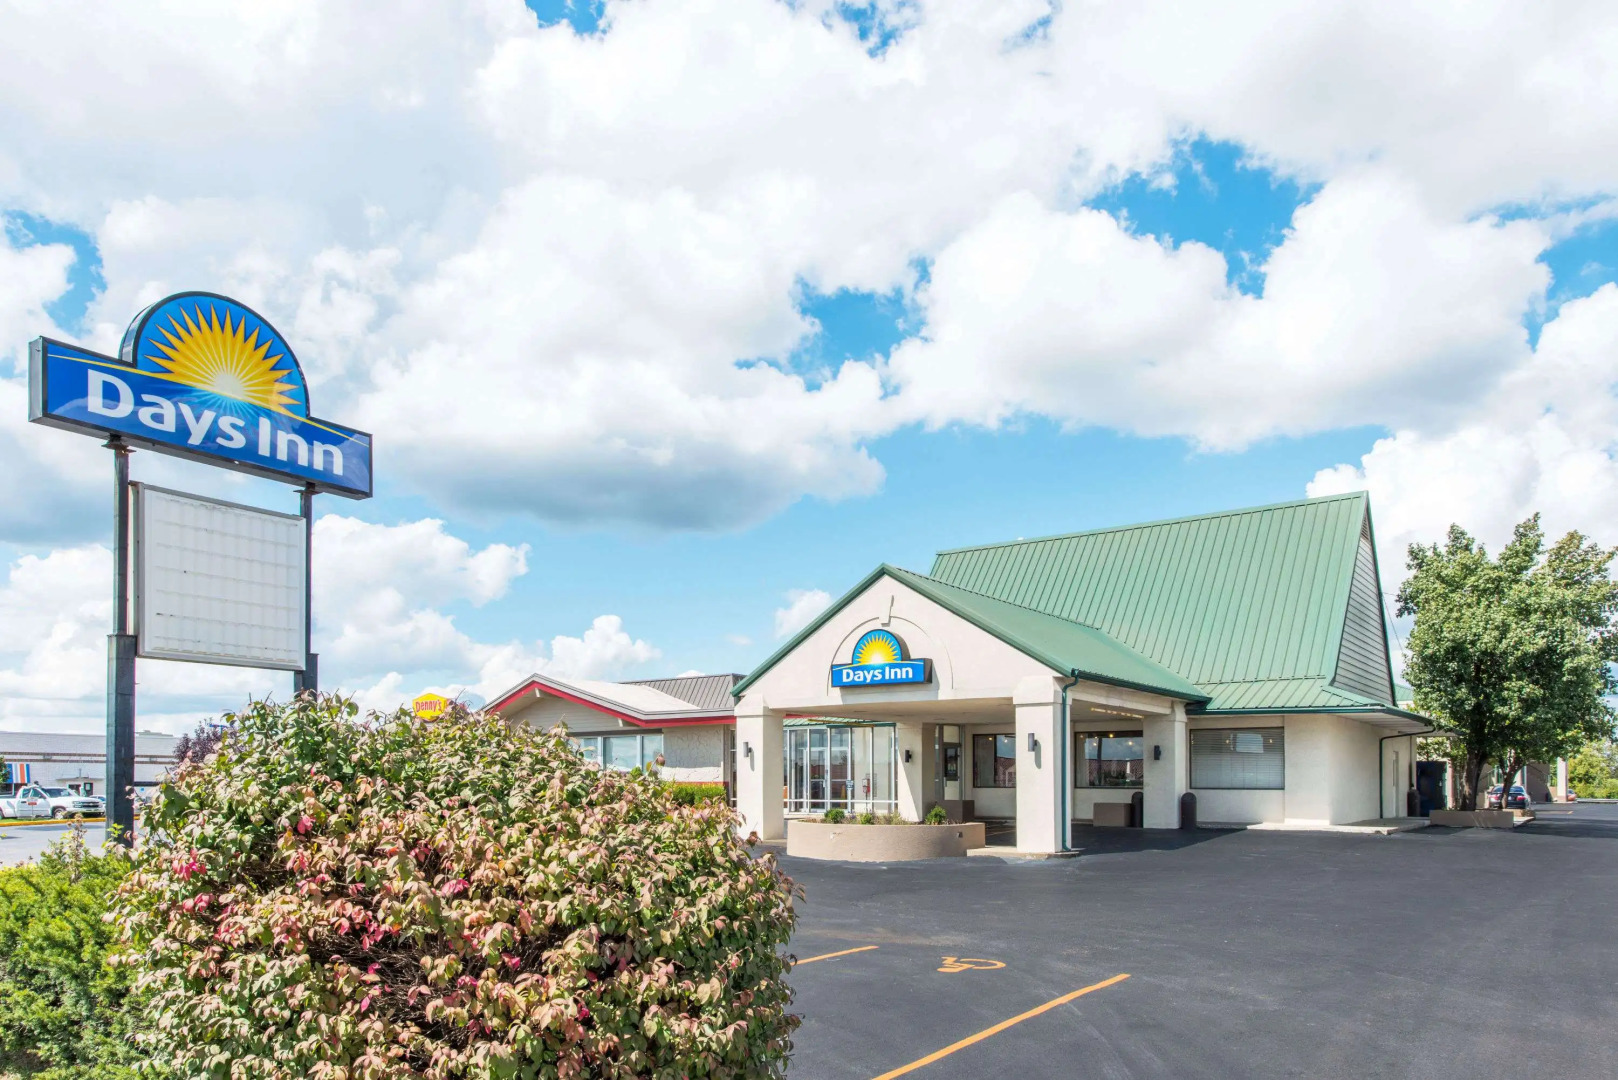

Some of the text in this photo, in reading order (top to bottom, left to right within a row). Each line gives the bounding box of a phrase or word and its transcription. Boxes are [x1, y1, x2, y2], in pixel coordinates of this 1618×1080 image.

[87, 368, 344, 476] Days Inn
[842, 666, 913, 683] Days Inn
[415, 699, 443, 713] Denny's
